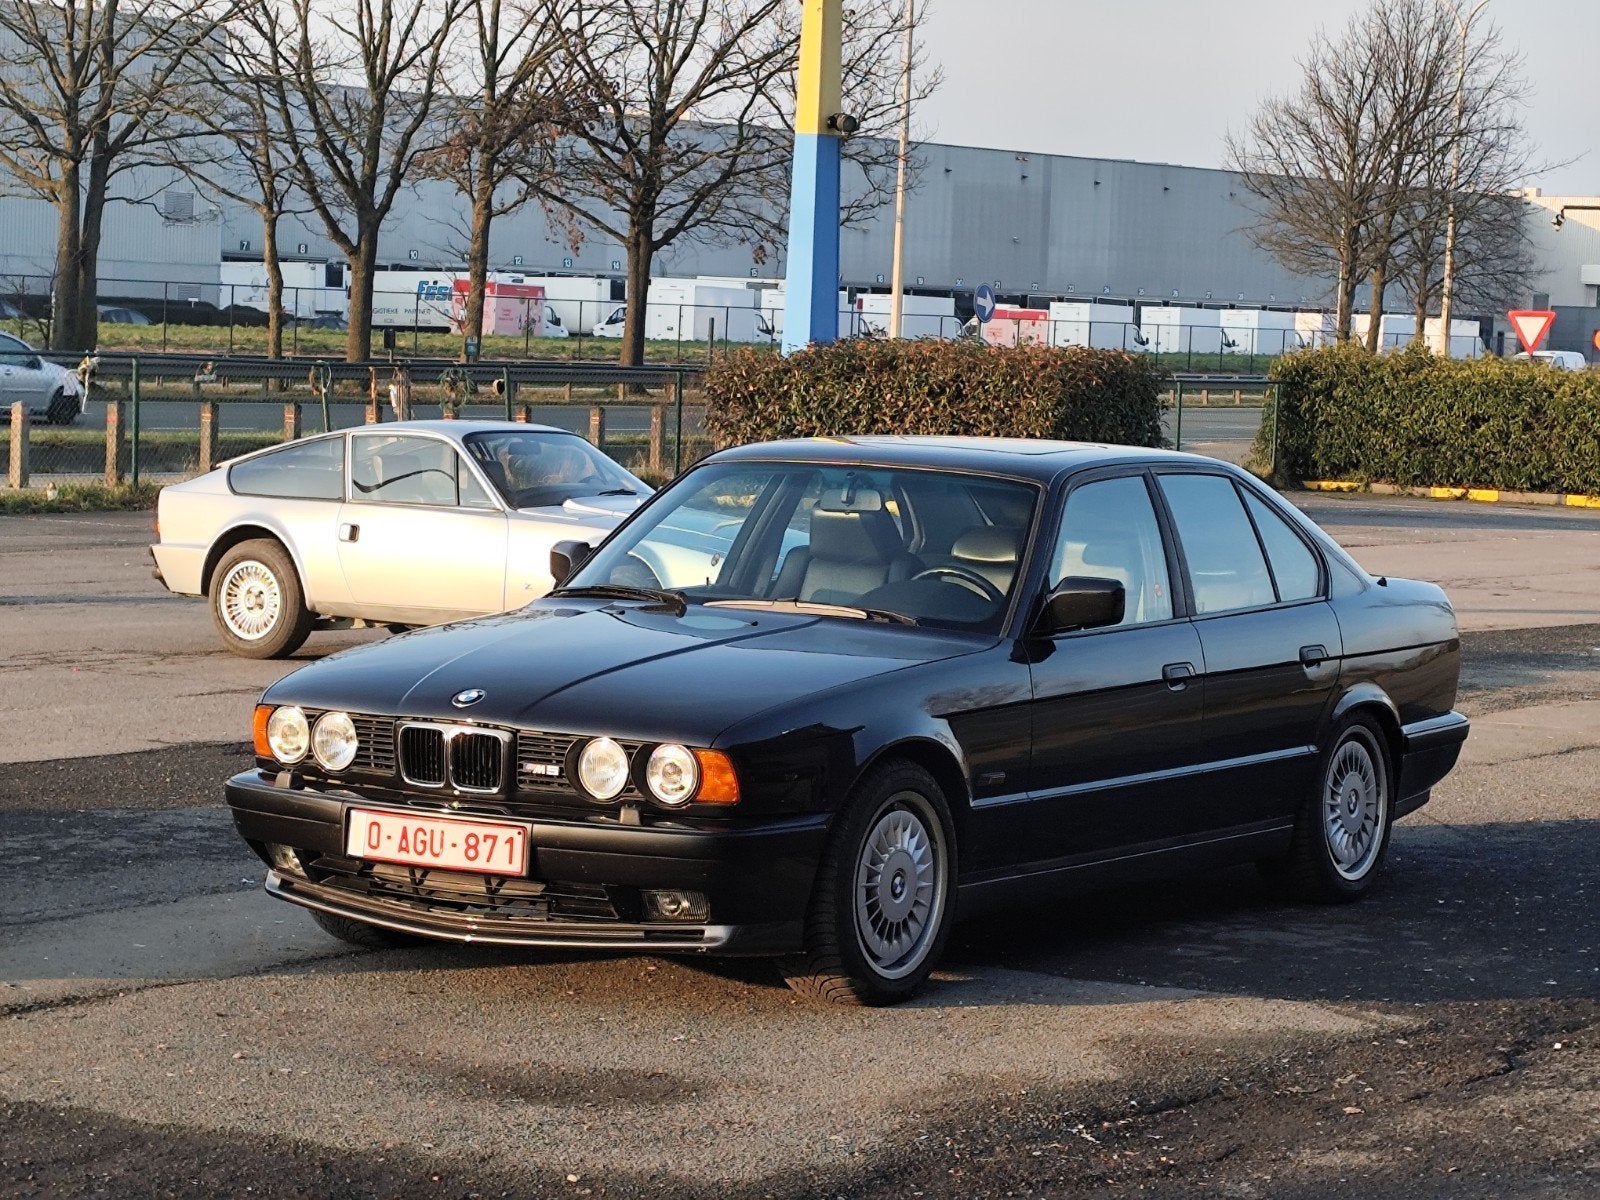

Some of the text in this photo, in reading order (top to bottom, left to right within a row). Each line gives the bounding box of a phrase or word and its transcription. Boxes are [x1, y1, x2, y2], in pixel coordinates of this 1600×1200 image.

[242, 241, 248, 250] 7
[300, 244, 306, 253] 8
[410, 250, 418, 259] 10
[515, 256, 522, 265] 12
[564, 258, 572, 268] 13
[613, 261, 620, 270] 14
